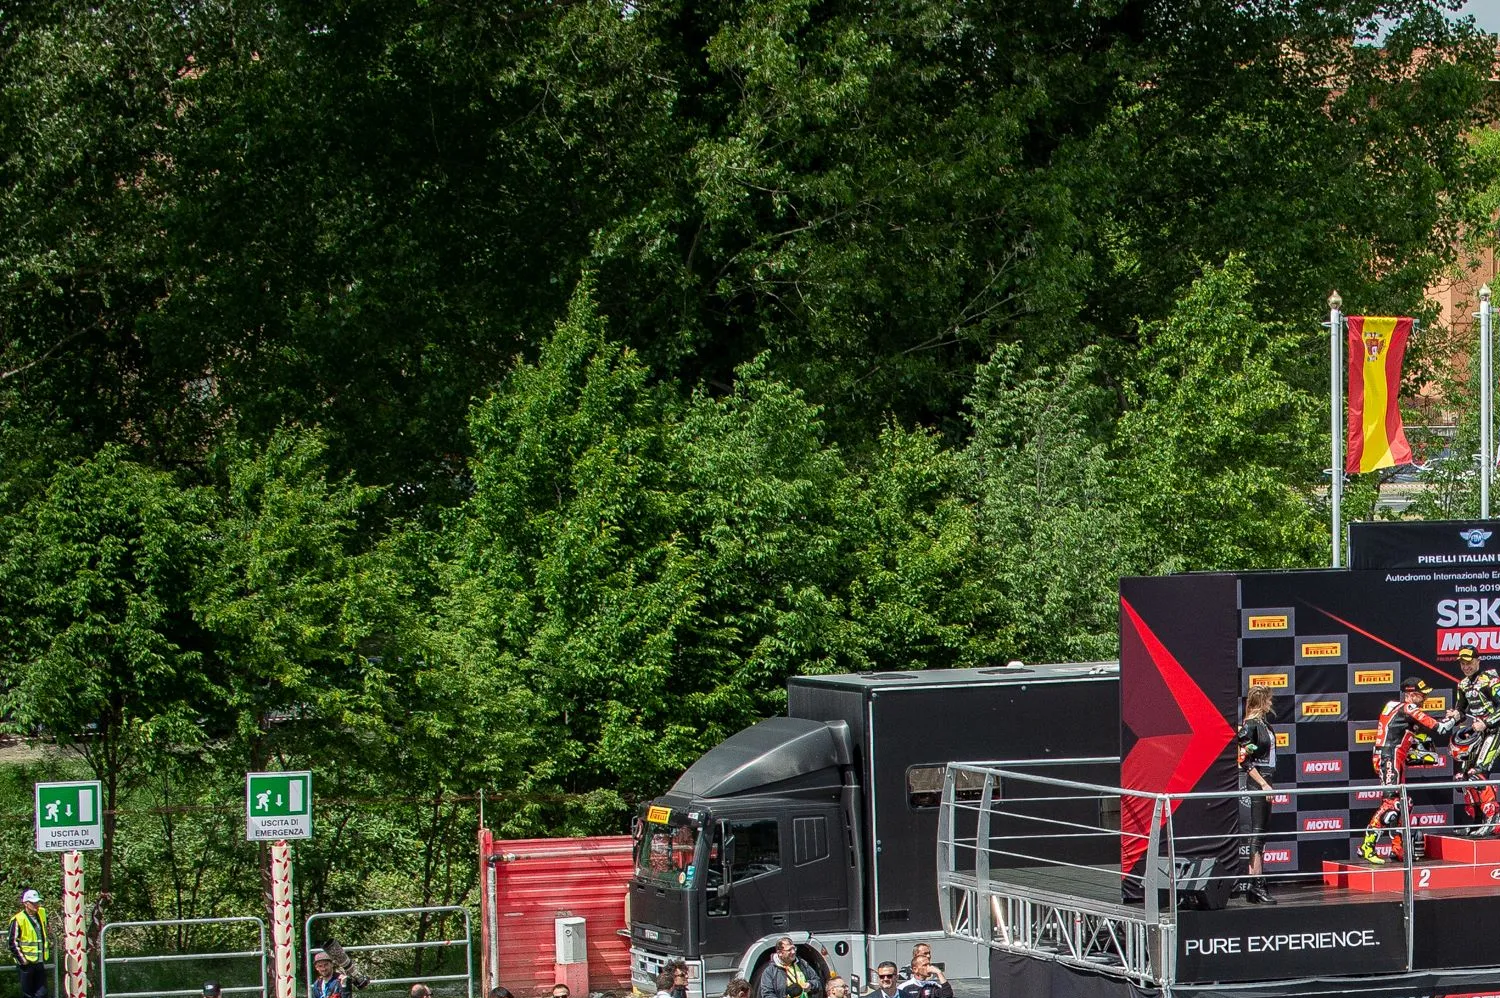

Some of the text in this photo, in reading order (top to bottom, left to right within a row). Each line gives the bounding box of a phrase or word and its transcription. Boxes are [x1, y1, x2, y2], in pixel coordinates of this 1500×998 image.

[1418, 555, 1456, 564] PIRELLI
[1458, 554, 1495, 563] ITALIAN
[1385, 573, 1431, 582] Autodromo
[1433, 571, 1490, 581] Internazionale
[1455, 584, 1500, 593] Imola 2019
[1252, 618, 1286, 628] PIRELLI
[1305, 645, 1338, 655] PIRELLI
[1358, 671, 1392, 682] PIRELLI
[1305, 703, 1338, 714] PIRELLI
[1305, 762, 1340, 772] MOTUL
[261, 818, 299, 827] USCITA DI
[1306, 820, 1341, 830] MOTUL
[51, 829, 90, 838] USCITA DI
[255, 827, 305, 837] EMERGENZA
[45, 839, 95, 848] EMERGENZA
[1419, 869, 1431, 887] 2
[1185, 930, 1381, 956] PURE EXPERIENCE.
